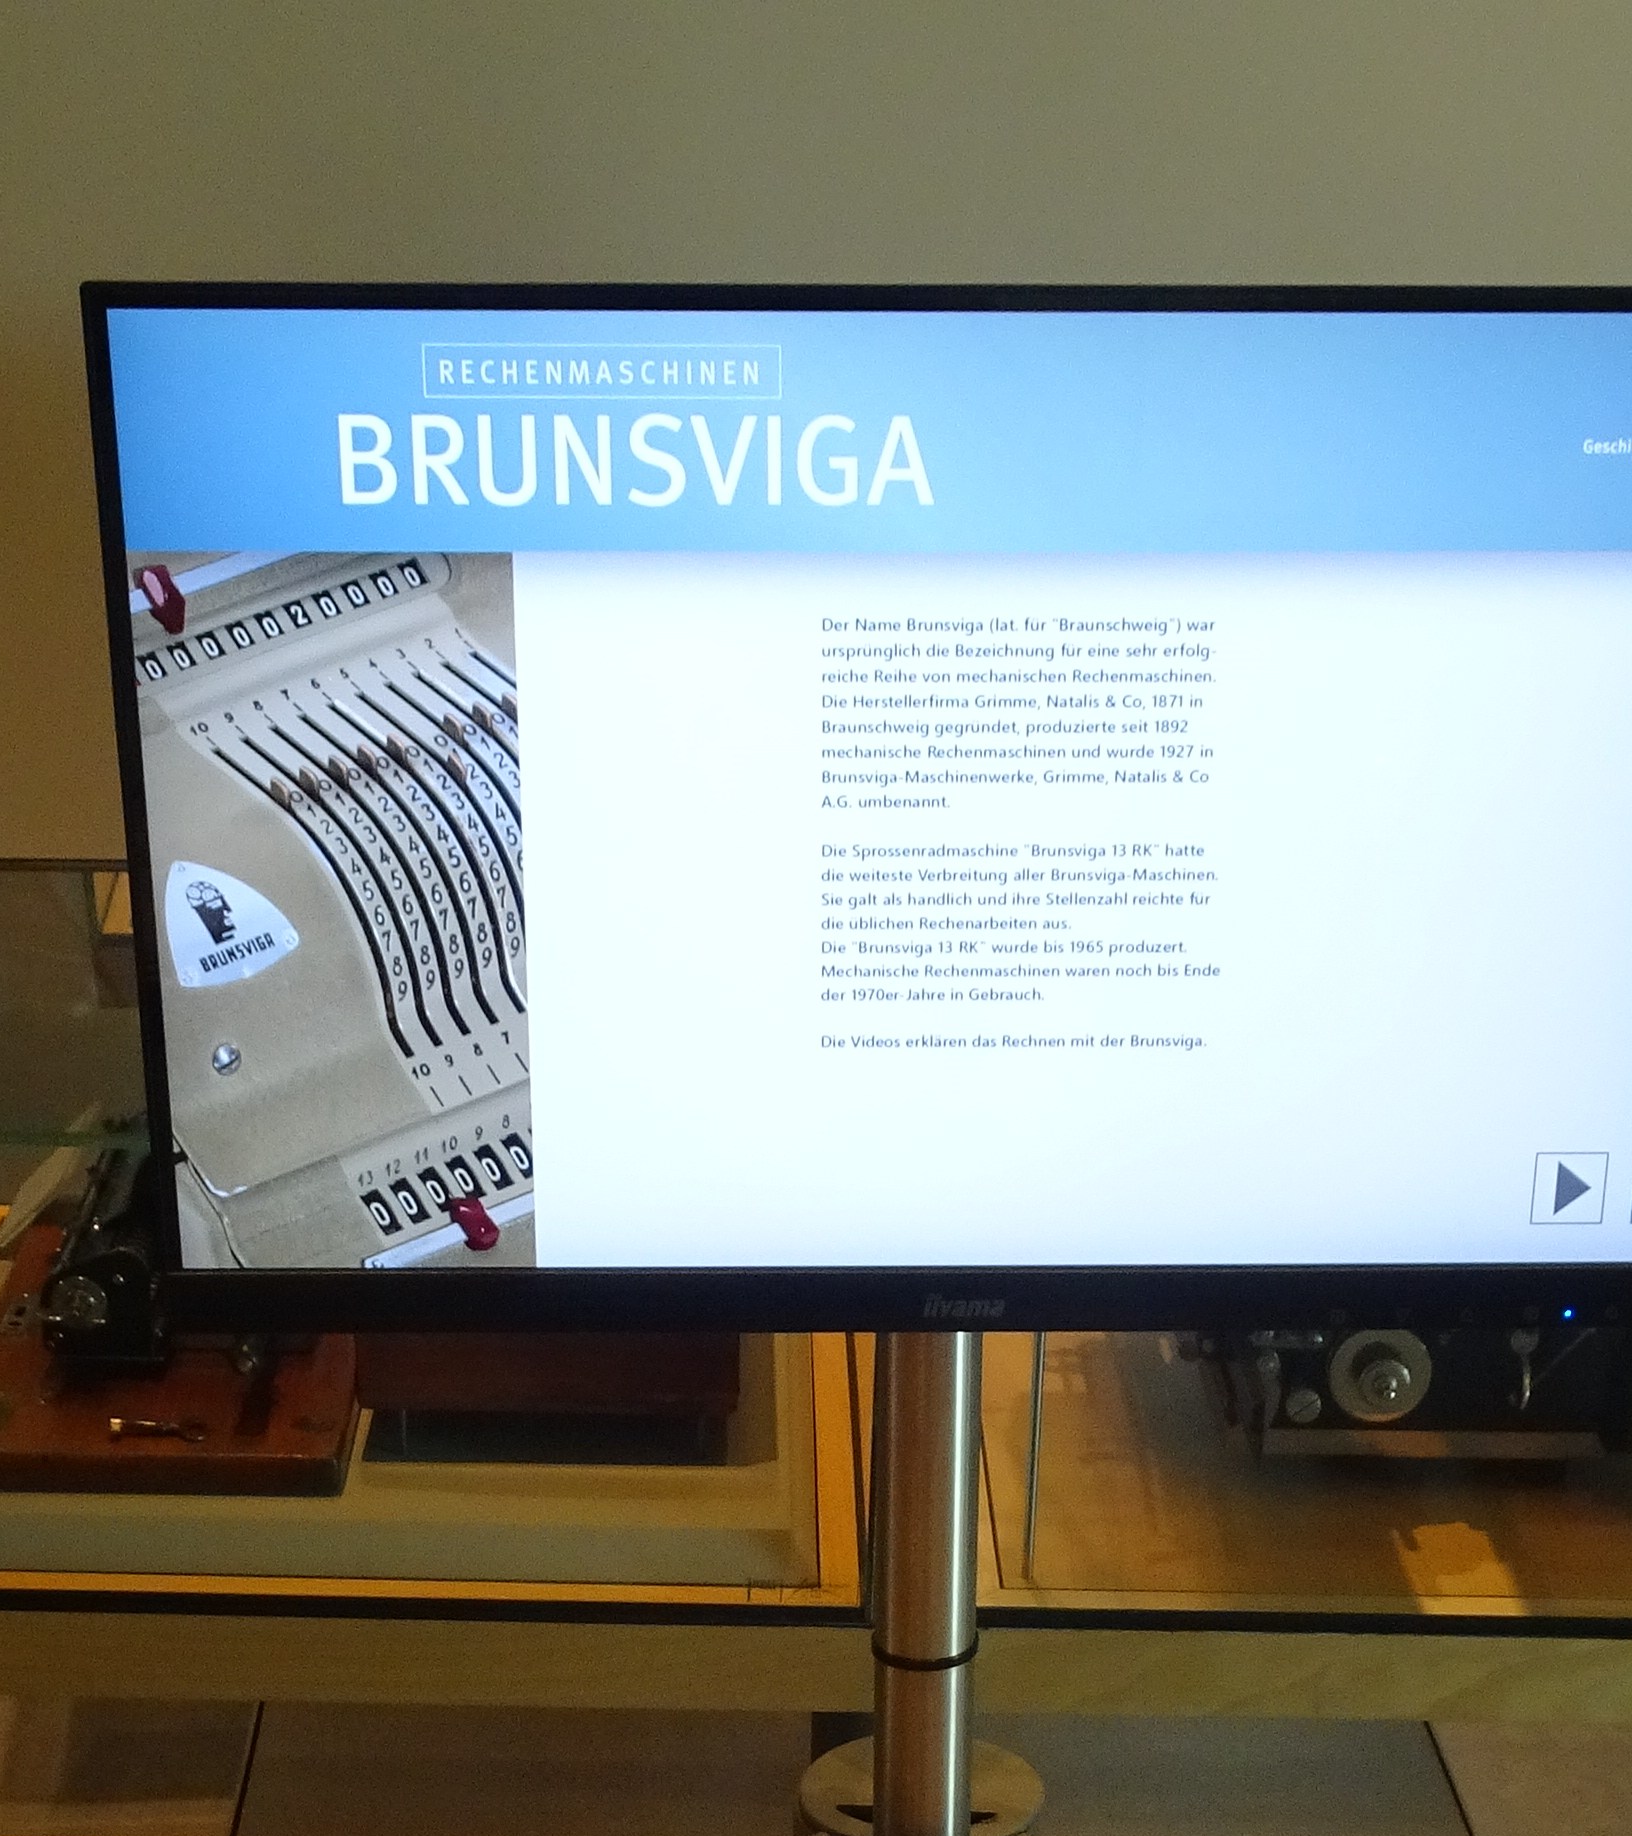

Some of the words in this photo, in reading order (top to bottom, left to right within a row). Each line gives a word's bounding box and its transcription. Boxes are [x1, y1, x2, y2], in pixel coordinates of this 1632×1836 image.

[438, 359, 761, 386] RECHENMASCHINEN
[336, 412, 936, 508] BRUNSVIGA
[145, 659, 163, 679] 0
[173, 649, 192, 669] 0
[201, 637, 220, 658] 0
[232, 626, 251, 647] 0
[261, 616, 280, 637] 0
[289, 604, 309, 626] 2
[319, 596, 337, 617] 0
[346, 585, 365, 605] 0
[376, 575, 395, 597] 0
[403, 566, 422, 587] 0
[821, 617, 850, 632] Der
[855, 617, 902, 632] Name
[906, 617, 984, 637] Brunsviga
[1024, 616, 1047, 632] für
[1186, 621, 1216, 632] war
[821, 642, 921, 662] ursprünglich
[925, 643, 950, 658] die
[955, 642, 1055, 663] Bezeichnung
[1061, 642, 1083, 658] für
[1087, 642, 1120, 658] eine
[1125, 642, 1158, 658] sehr
[1162, 642, 1217, 662] erfolg-
[821, 668, 869, 684] reiche
[873, 668, 918, 684] Reihe
[921, 672, 951, 684] von
[956, 668, 1067, 684] mechanischen
[1072, 668, 1217, 683] Rechenmaschinen.
[189, 721, 209, 736] 10
[223, 711, 235, 724] 9
[252, 699, 264, 712] 8
[279, 688, 290, 701] 7
[310, 678, 321, 690] 6
[339, 667, 350, 680] 5
[368, 657, 378, 669] 4
[395, 648, 407, 660] 3
[424, 637, 435, 650] 2
[821, 694, 848, 709] Die
[852, 693, 970, 709] Herstellerfirma
[974, 694, 1041, 711] Grimme,
[1046, 693, 1100, 709] Natalis
[1104, 694, 1117, 709] &
[1121, 694, 1146, 711] Co,
[1151, 694, 1184, 709] 1871
[1189, 694, 1203, 708] in
[821, 719, 930, 738] Braunschweig
[934, 719, 1020, 739] gegründet,
[1025, 719, 1117, 738] produzierte
[1121, 719, 1149, 734] seit
[1154, 719, 1189, 734] 1892
[821, 744, 922, 759] mechanische
[927, 744, 1067, 759] Rechenmaschinen
[1071, 743, 1101, 759] und
[1106, 744, 1155, 759] wurde
[1160, 744, 1195, 759] 1927
[1199, 744, 1214, 758] in
[821, 769, 1038, 788] Brunsviga-Maschinenwerke,
[1042, 769, 1109, 786] Grimme,
[1114, 769, 1168, 784] Natalis
[1172, 769, 1184, 784] &
[1189, 769, 1210, 784] Co
[306, 803, 318, 819] 1
[821, 794, 853, 809] A.G.
[858, 794, 951, 809] umbenannt.
[320, 819, 334, 836] 2
[335, 837, 349, 855] 3
[821, 844, 847, 858] Die
[852, 843, 1019, 862] Sprossenradmaschine
[1111, 843, 1127, 858] 13
[1164, 842, 1205, 857] hatte
[351, 857, 363, 876] 4
[820, 868, 845, 882] die
[848, 868, 913, 882] weiteste
[917, 867, 1008, 886] Verbreitung
[1013, 867, 1046, 882] aller
[1050, 867, 1219, 886] Brunsviga-Maschinen.
[362, 880, 375, 902] 5
[821, 892, 844, 907] Sie
[847, 892, 878, 911] galt
[882, 891, 903, 906] als
[907, 891, 973, 906] handlich
[977, 891, 1008, 906] und
[1011, 891, 1041, 906] ihre
[1045, 891, 1128, 906] Stellenzahl
[1132, 891, 1184, 906] reichte
[1189, 891, 1211, 906] für
[374, 904, 386, 927] 6
[820, 916, 844, 931] die
[848, 916, 914, 931] üblichen
[919, 915, 1038, 930] Rechenarbeiten
[1042, 919, 1072, 930] aus.
[381, 929, 392, 953] 7
[821, 940, 847, 954] Die
[938, 940, 953, 954] 13
[991, 939, 1039, 954] wurde
[1043, 939, 1065, 954] bis
[1069, 940, 1104, 954] 1965
[1108, 939, 1187, 958] produzert.
[200, 932, 276, 974] BRUNSVIGA
[392, 955, 404, 977] 8
[821, 963, 920, 978] Mechanische
[924, 963, 1061, 978] Rechenmaschinen
[1064, 966, 1110, 977] waren
[1115, 963, 1153, 977] noch
[1156, 963, 1180, 977] bis
[1183, 963, 1221, 977] Ende
[397, 980, 408, 1002] 9
[820, 987, 846, 1002] der
[851, 987, 946, 1002] 1970er-Jahre
[950, 987, 964, 1001] in
[968, 987, 1045, 1001] Gebrauch.
[820, 1034, 846, 1049] Die
[850, 1034, 901, 1049] Videos
[905, 1034, 967, 1048] erklären
[971, 1034, 997, 1048] das
[1001, 1034, 1066, 1048] Rechnen
[1070, 1034, 1095, 1048] mit
[1099, 1034, 1126, 1048] der
[1130, 1034, 1208, 1052] Brunsviga.
[411, 1063, 432, 1080] 10
[444, 1054, 455, 1068] 9
[473, 1042, 484, 1057] 8
[501, 1030, 511, 1046] 7
[358, 1169, 374, 1188] 13
[385, 1159, 401, 1177] 12
[414, 1146, 430, 1165] 11
[441, 1135, 458, 1154] 10
[474, 1125, 484, 1142] 9
[501, 1113, 511, 1130] 8
[369, 1202, 391, 1227] 0
[397, 1190, 419, 1216] 0
[425, 1180, 447, 1205] 0
[453, 1167, 475, 1193] 0
[481, 1157, 502, 1183] 0
[509, 1145, 531, 1171] 0
